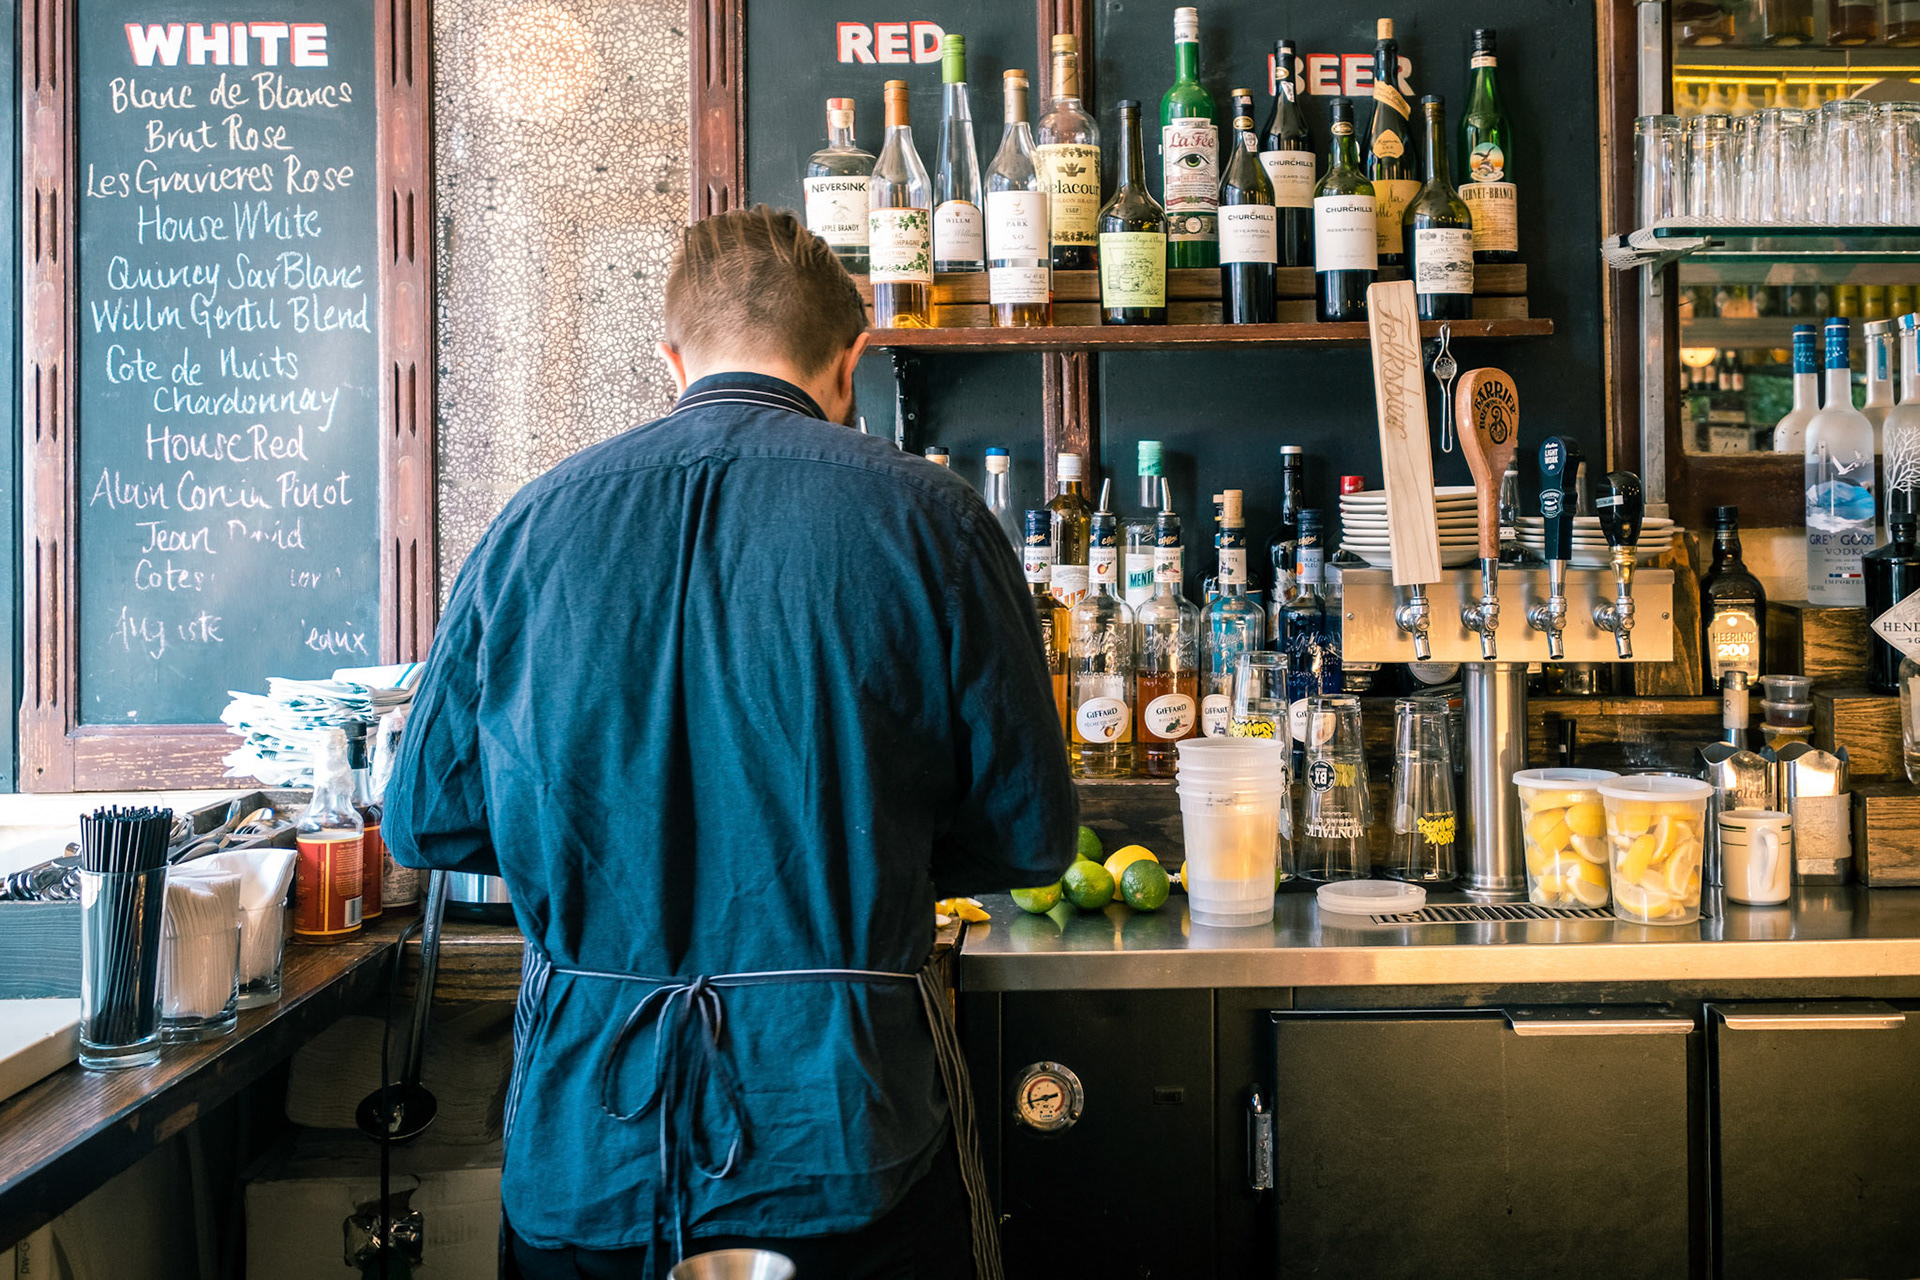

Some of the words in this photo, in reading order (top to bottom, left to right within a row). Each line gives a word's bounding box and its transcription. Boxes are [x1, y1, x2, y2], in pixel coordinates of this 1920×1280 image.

[125, 21, 329, 67] WHITE
[836, 21, 945, 63] RED
[109, 77, 197, 113] Blanc
[210, 73, 249, 109] de
[252, 71, 352, 110] Blancs
[1267, 53, 1416, 96] BEER
[144, 119, 217, 153] Brut
[222, 113, 294, 151] Rose
[1169, 131, 1189, 148] La
[1190, 131, 1215, 148] Fée
[283, 154, 354, 195] Rose
[811, 182, 866, 193] NEVERSINK
[1462, 187, 1514, 200] FERNET-BRANCA
[137, 204, 229, 245] House
[233, 200, 322, 241] White
[1006, 220, 1028, 228] PARK
[108, 255, 221, 307] Quincy
[288, 293, 372, 334] Blend
[106, 344, 163, 384] Cote
[171, 347, 204, 386] de
[1376, 300, 1421, 440] Folksbier
[153, 386, 339, 432] Chardonnay
[1474, 380, 1517, 415] BARRIER
[276, 470, 353, 509] Pinot
[136, 520, 217, 554] Jean
[1825, 547, 1864, 556] VODKA
[1840, 533, 1876, 546] GOOSE
[1718, 643, 1750, 656] 200
[1086, 707, 1118, 719] GIFFARD
[1156, 703, 1187, 715] GIFFARD
[1305, 823, 1364, 839] MONTAUK
